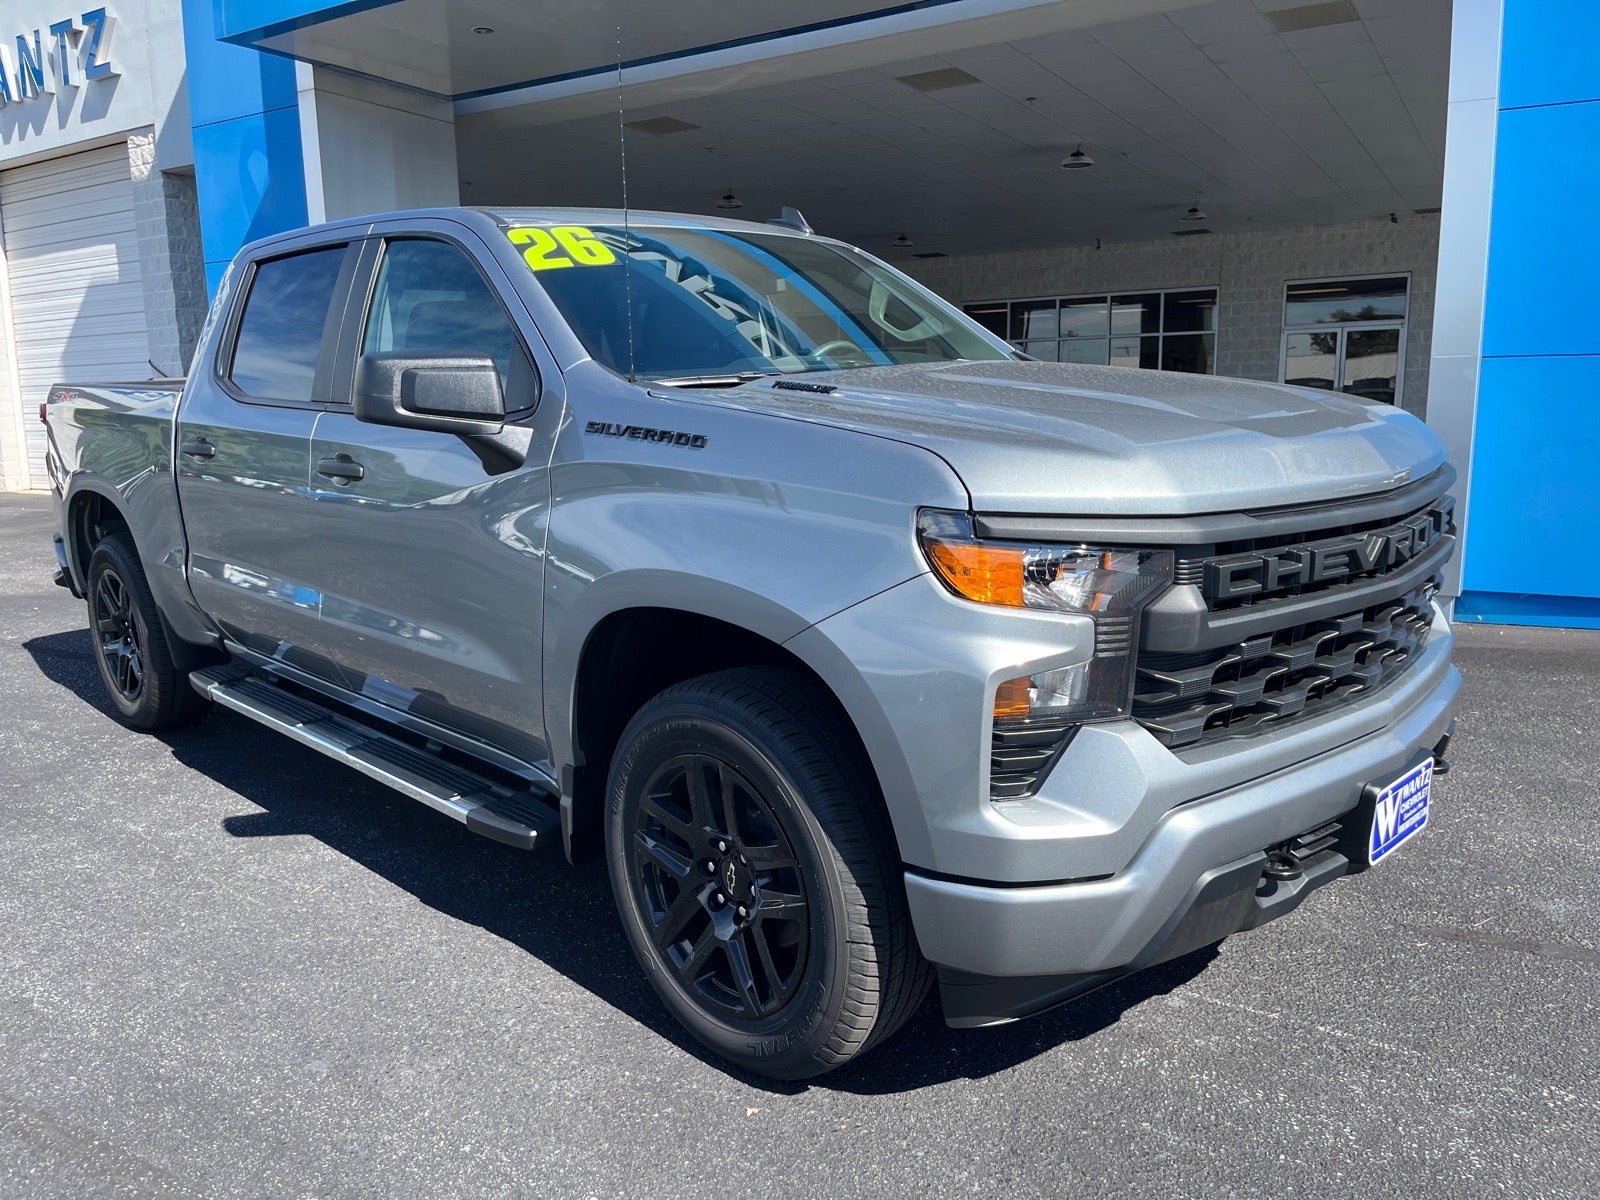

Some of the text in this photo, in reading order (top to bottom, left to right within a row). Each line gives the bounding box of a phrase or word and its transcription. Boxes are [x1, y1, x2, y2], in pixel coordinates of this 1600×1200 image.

[507, 226, 616, 271] 26
[585, 421, 709, 448] SILVERADO
[1203, 497, 1456, 599] CHEVROLE
[1403, 769, 1431, 799] WANTZ
[1401, 786, 1428, 813] CHEVROLET
